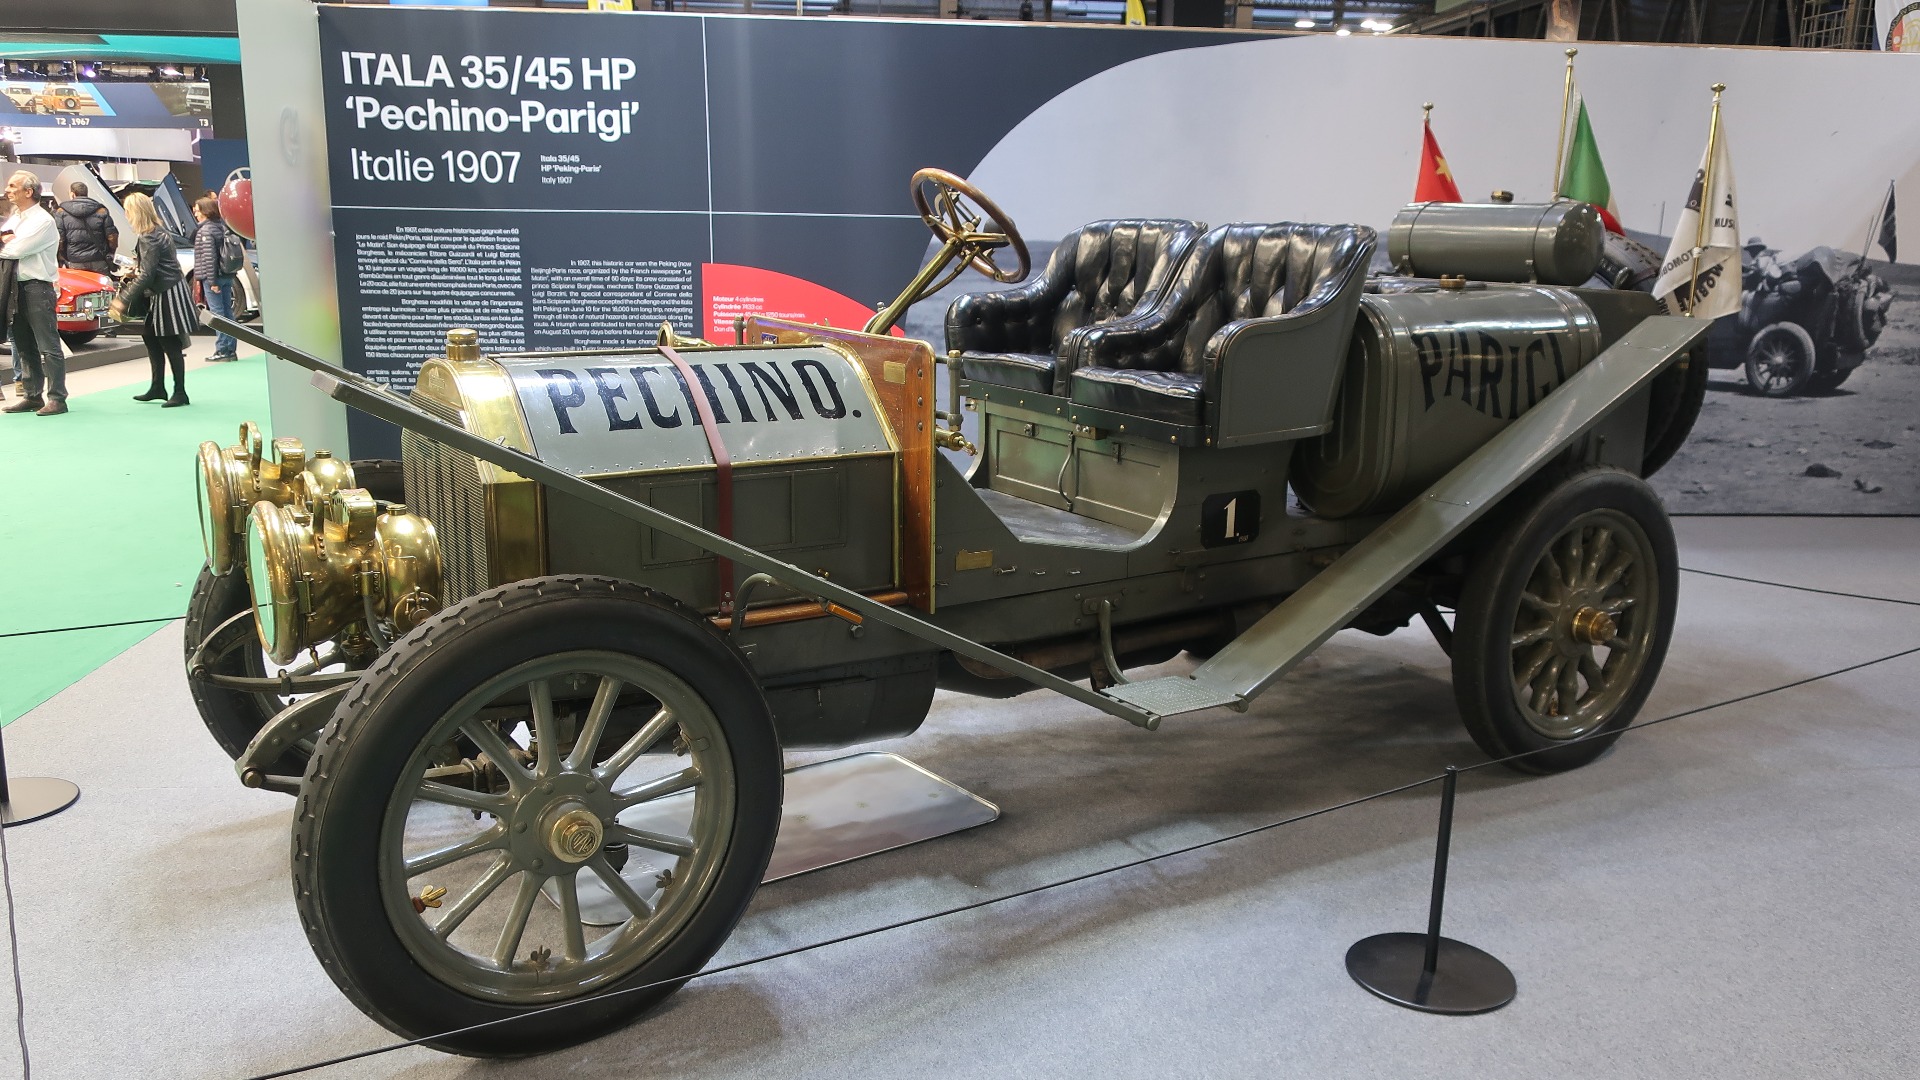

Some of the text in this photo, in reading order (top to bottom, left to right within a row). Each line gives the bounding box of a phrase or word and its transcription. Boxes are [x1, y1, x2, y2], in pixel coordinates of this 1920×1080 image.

[341, 51, 637, 95] ITALA 35/45 HP
[55, 118, 90, 126] T2 1967
[198, 118, 209, 126] T3
[345, 95, 640, 142] ‘Pechino-Parigi’
[351, 148, 521, 184] Italie 1907
[557, 154, 580, 163] 35/45
[541, 176, 556, 184] Italy
[534, 359, 862, 435] PECHINO.
